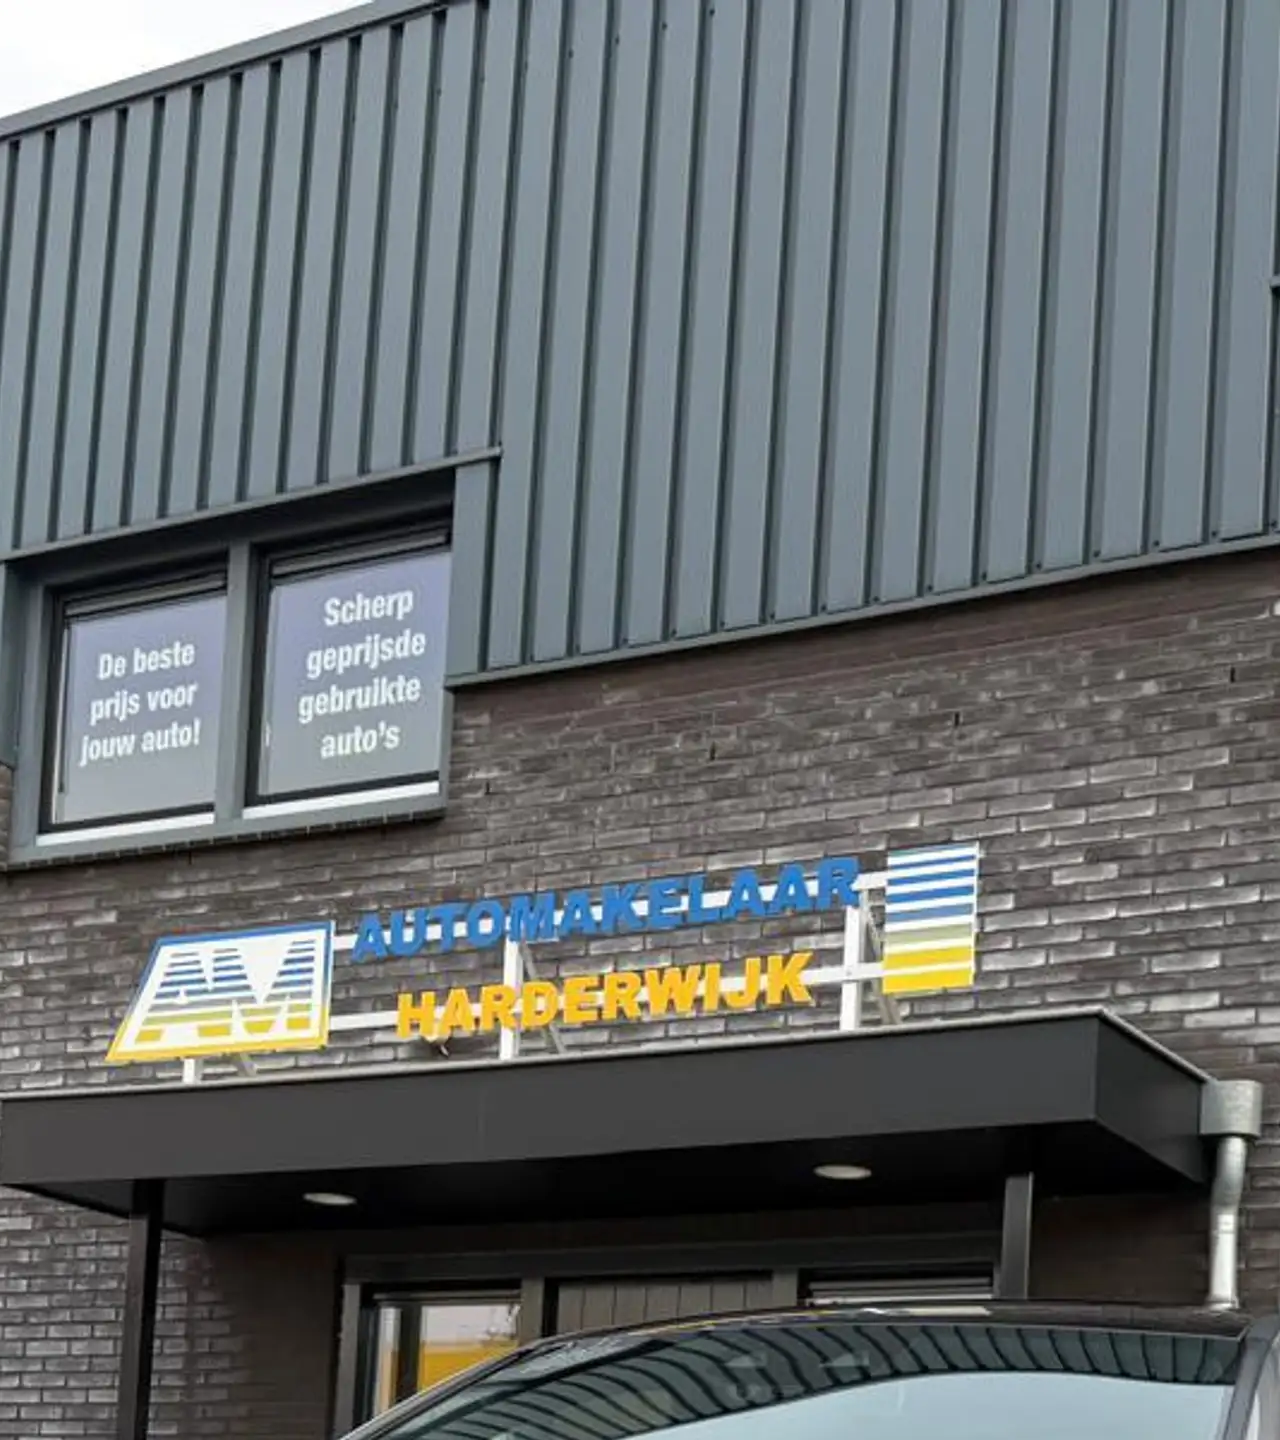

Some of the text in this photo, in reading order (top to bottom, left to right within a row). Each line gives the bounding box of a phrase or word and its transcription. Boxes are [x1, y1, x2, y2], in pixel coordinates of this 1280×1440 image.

[324, 588, 414, 627] Scherp
[97, 640, 196, 681] De beste
[306, 630, 426, 680] geprijsde
[90, 682, 198, 727] prijs voor
[298, 674, 421, 724] gebruikte
[78, 719, 201, 768] jouw auto!
[320, 720, 401, 760] auto's
[350, 856, 862, 962] AUTOMAKELAAR
[395, 950, 815, 1040] HARDERWIJK
